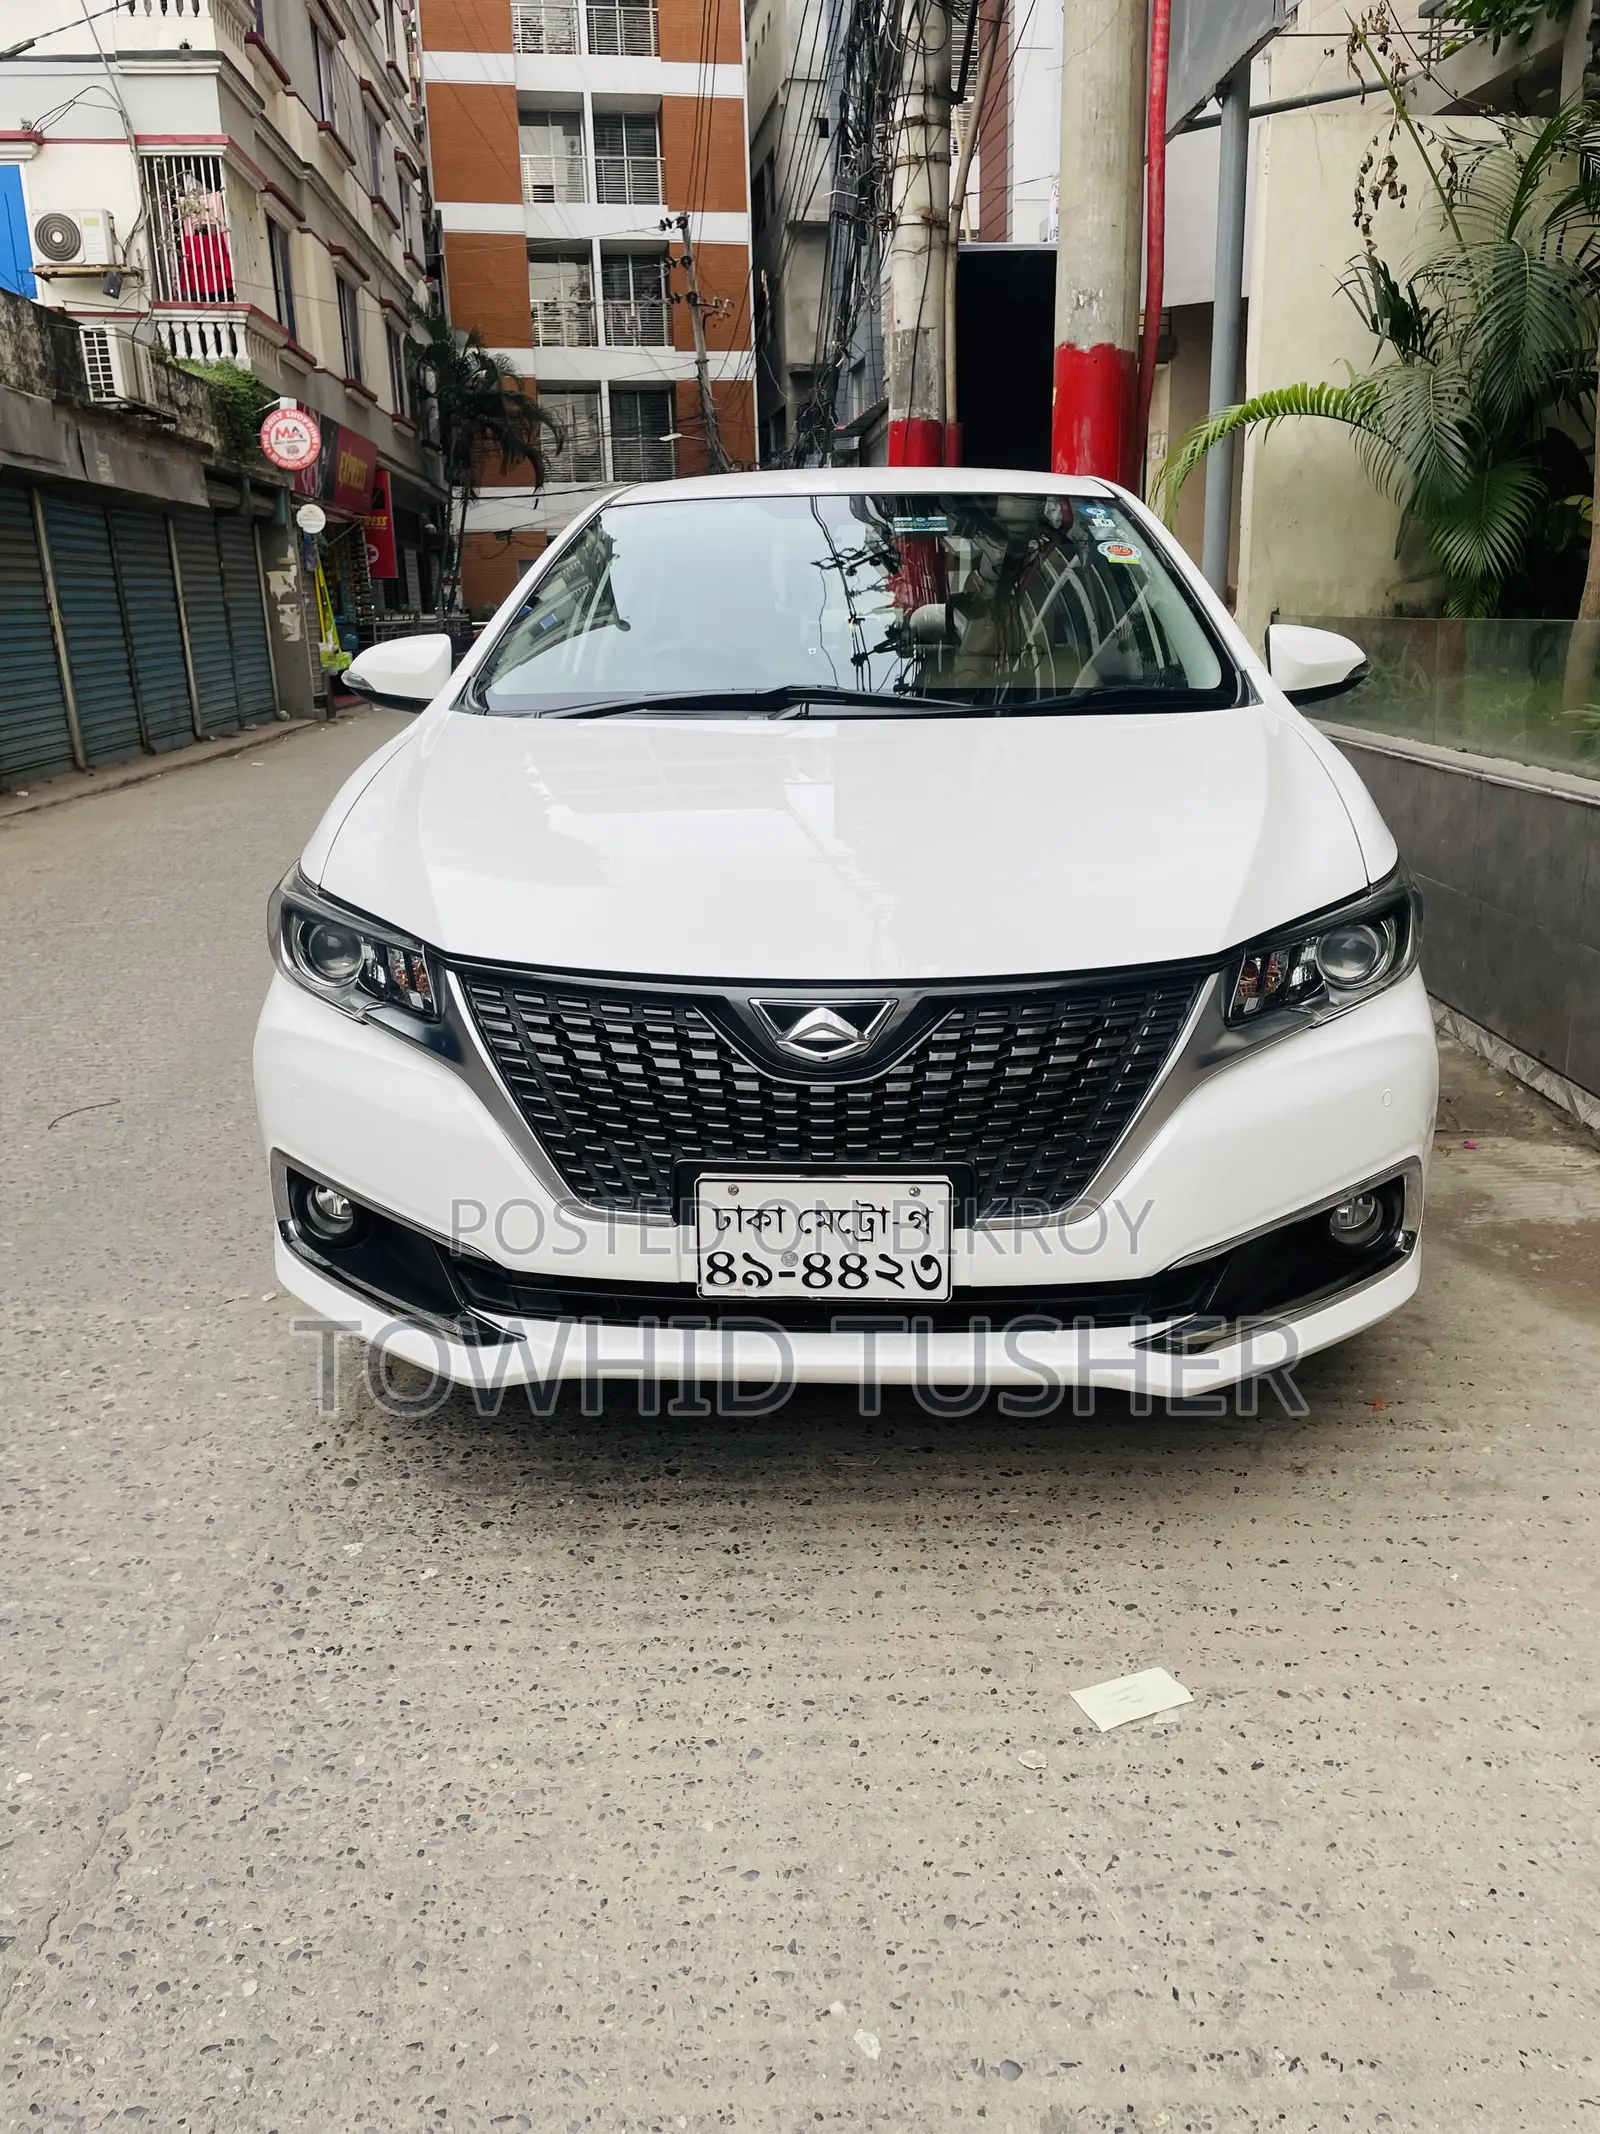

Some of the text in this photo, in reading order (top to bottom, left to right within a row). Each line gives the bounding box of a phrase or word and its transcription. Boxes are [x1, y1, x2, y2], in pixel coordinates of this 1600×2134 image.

[263, 411, 283, 431] DAILY
[285, 410, 320, 445] SHOPPING
[338, 449, 368, 491] EXPRESS
[712, 1204, 787, 1234] ঢাকা
[705, 1251, 942, 1290] ৪৯-৪৪২৩
